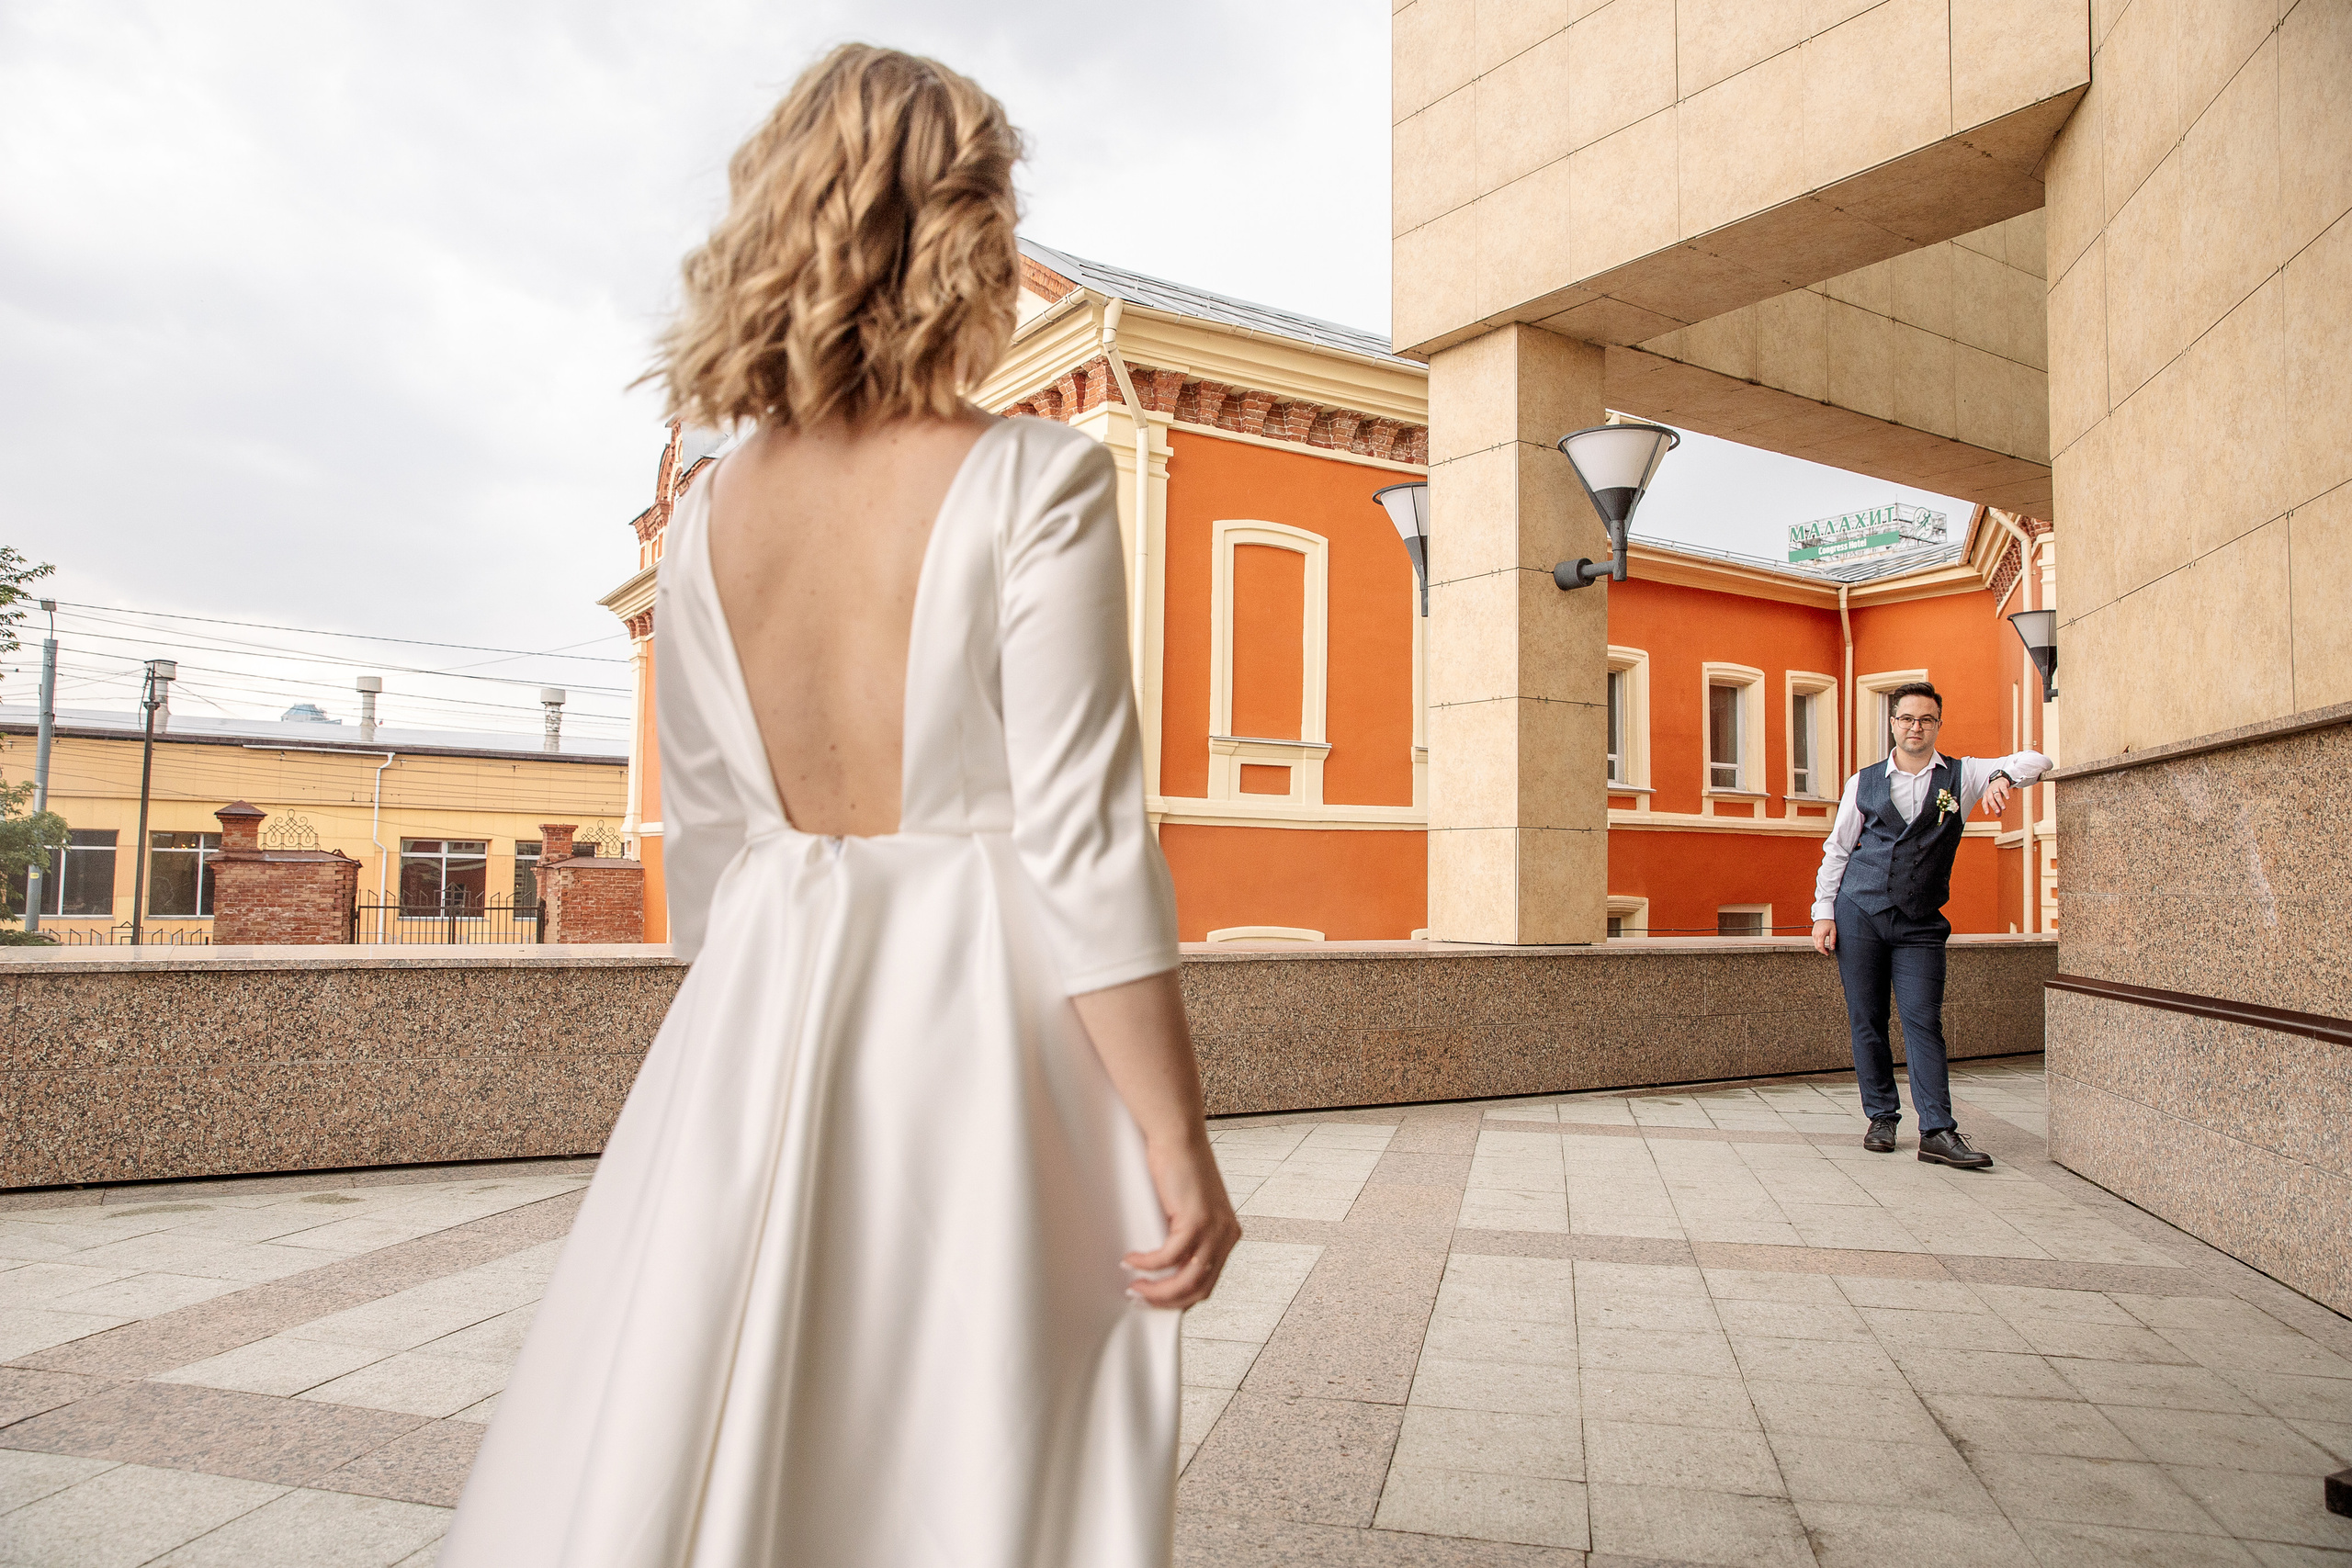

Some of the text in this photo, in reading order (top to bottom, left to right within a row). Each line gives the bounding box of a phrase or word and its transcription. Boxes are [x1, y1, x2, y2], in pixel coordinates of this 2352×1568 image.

[1789, 506, 1895, 543] МАЛАХИТ
[1818, 538, 1867, 555] Congress Hotel
